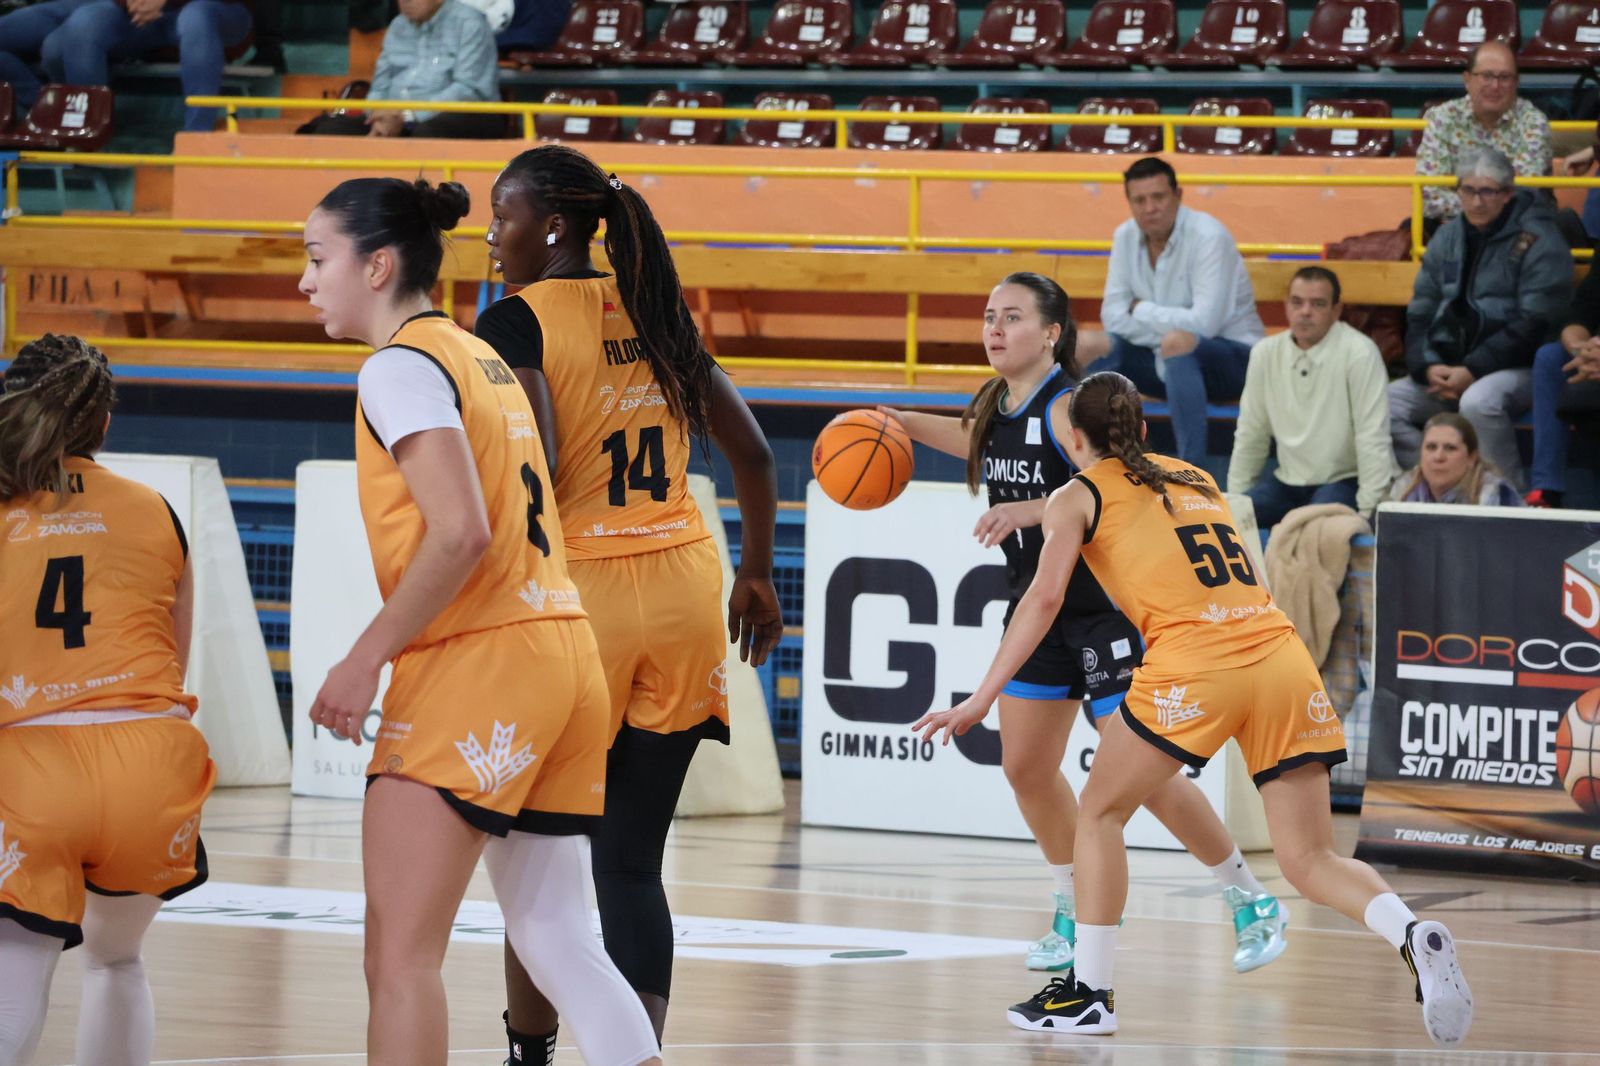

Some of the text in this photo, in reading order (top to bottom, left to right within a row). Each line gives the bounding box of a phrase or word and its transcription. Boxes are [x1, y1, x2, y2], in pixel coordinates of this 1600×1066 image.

[907, 4, 930, 25] 16
[1015, 8, 1036, 25] 14
[1235, 7, 1260, 25] 10
[1350, 6, 1367, 28] 8
[1466, 7, 1483, 28] 6
[620, 395, 668, 411] ZAMORA
[602, 426, 671, 507] 14
[985, 457, 1045, 485] OMUSA
[37, 522, 108, 538] ZAMORA
[1174, 522, 1258, 589] 55
[35, 555, 92, 650] 4
[1400, 700, 1560, 764] COMPITE
[821, 731, 934, 762] GIMNASIO
[313, 759, 361, 777] SALU
[1399, 755, 1557, 786] SIN MIEDOS
[1394, 828, 1469, 845] TENEMOS
[1472, 834, 1507, 848] LOS
[1510, 838, 1586, 856] MEJORES
